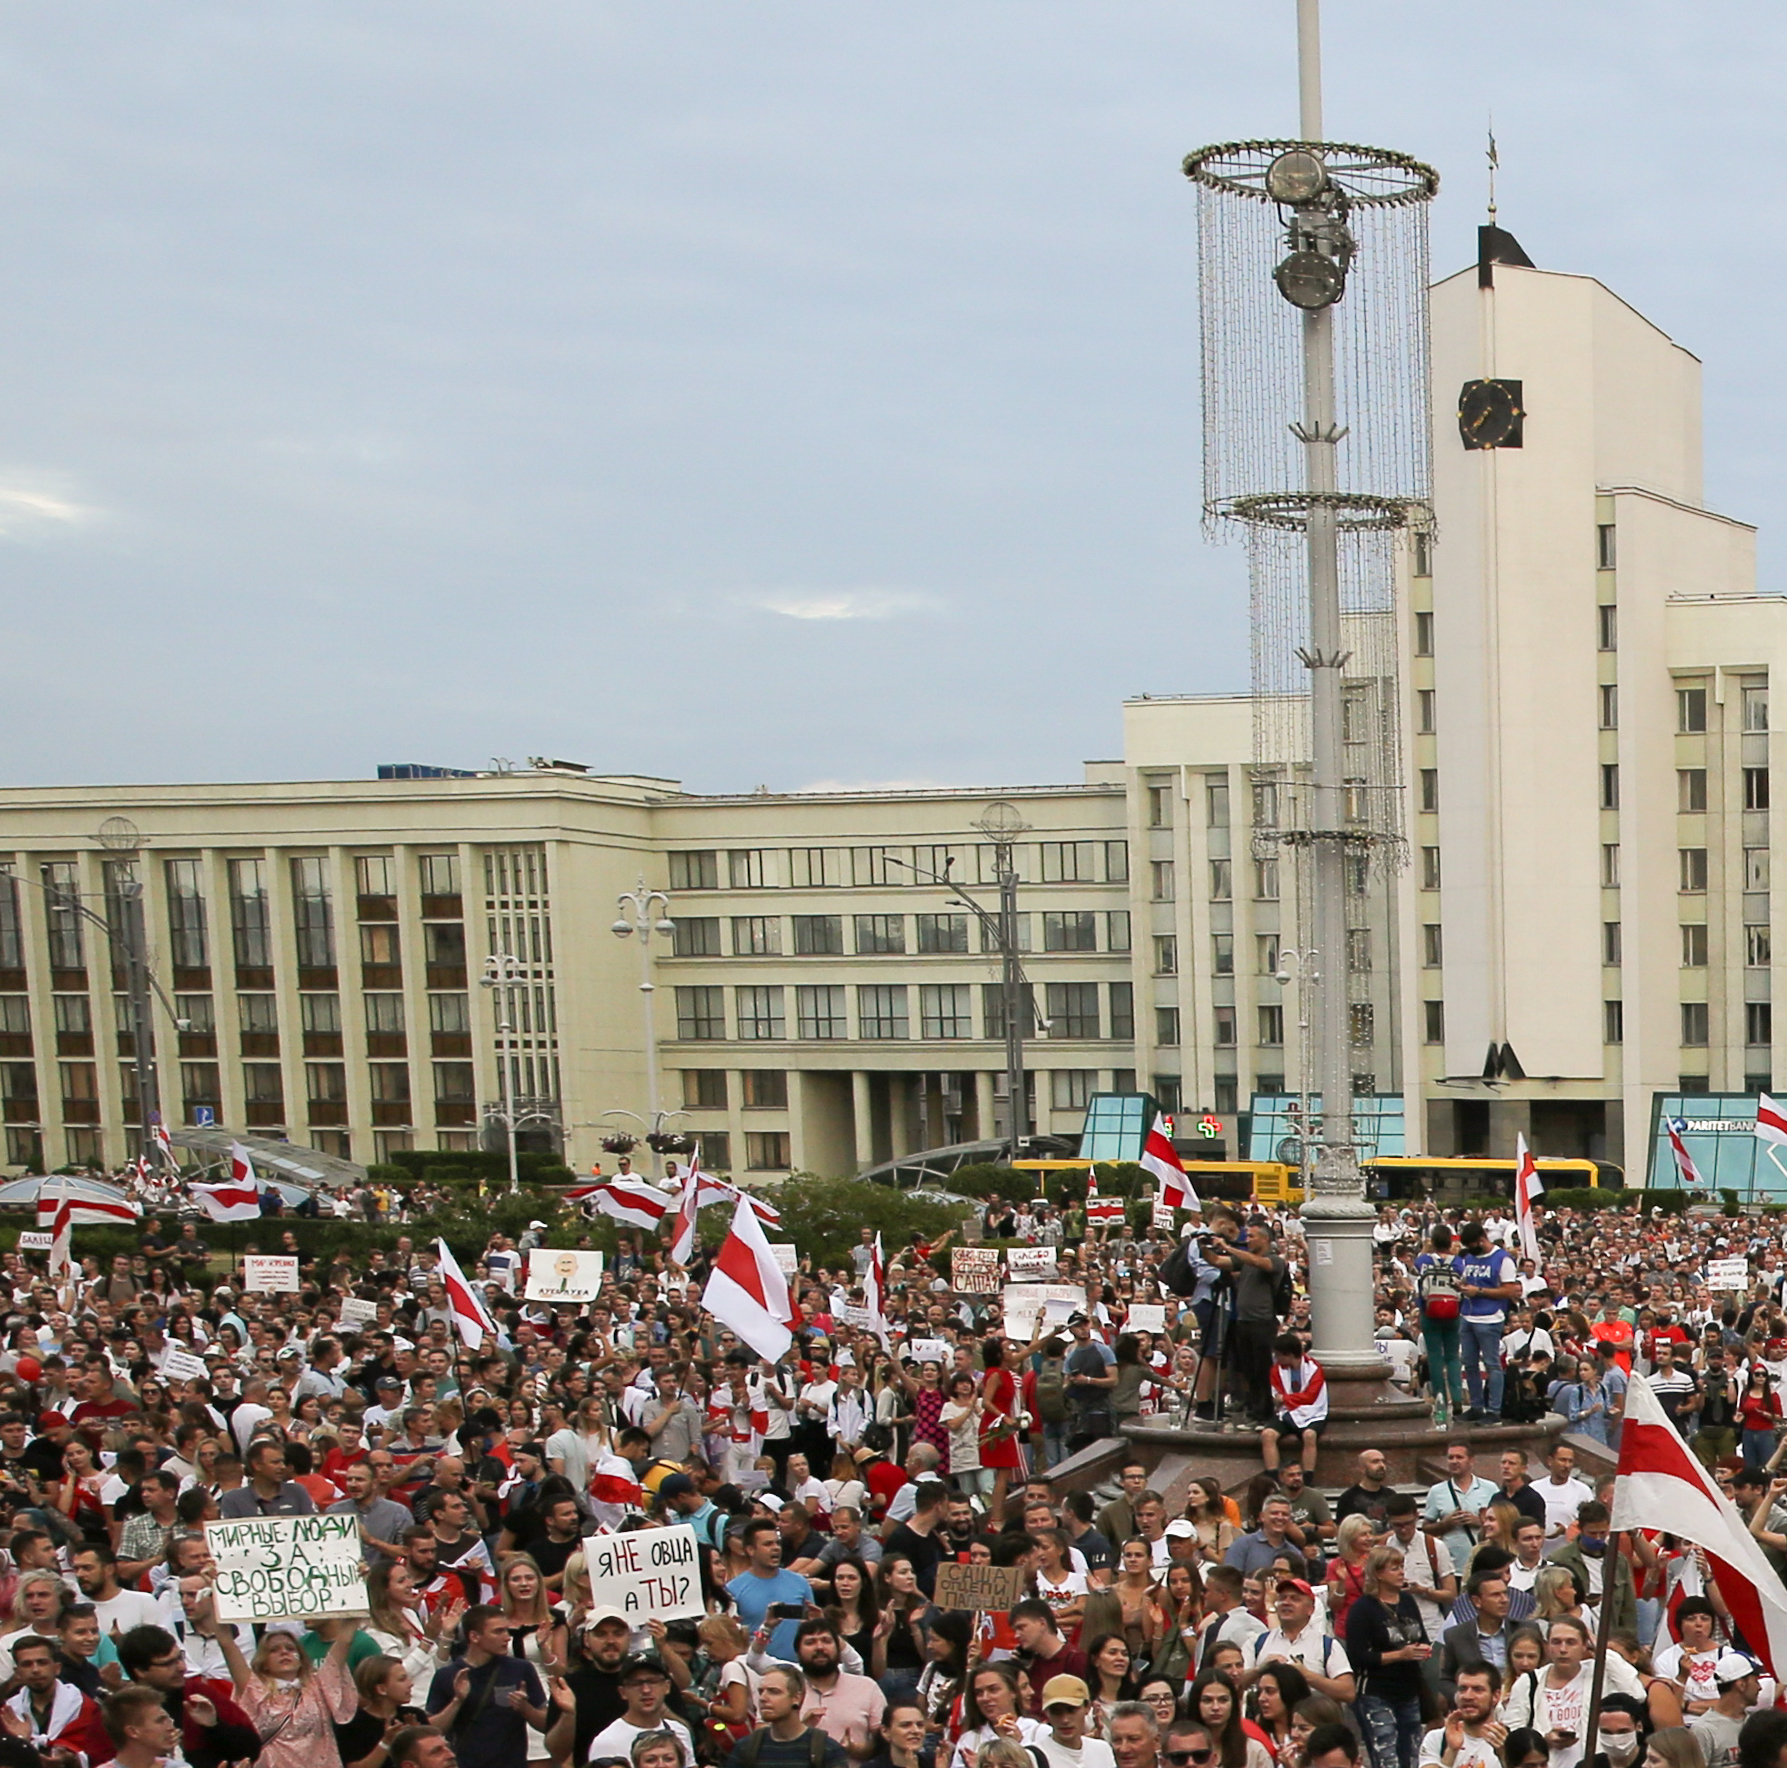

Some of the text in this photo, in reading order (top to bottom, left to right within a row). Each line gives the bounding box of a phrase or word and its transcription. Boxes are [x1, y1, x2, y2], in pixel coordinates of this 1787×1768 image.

[208, 1515, 359, 1549] МИРНЫЕ ЛЮДИ
[259, 1543, 311, 1568] ЗА
[598, 1536, 694, 1578] Я НЕ ОВЦА
[251, 1587, 332, 1617] ВЫБОР
[638, 1574, 690, 1609] ТЫ?
